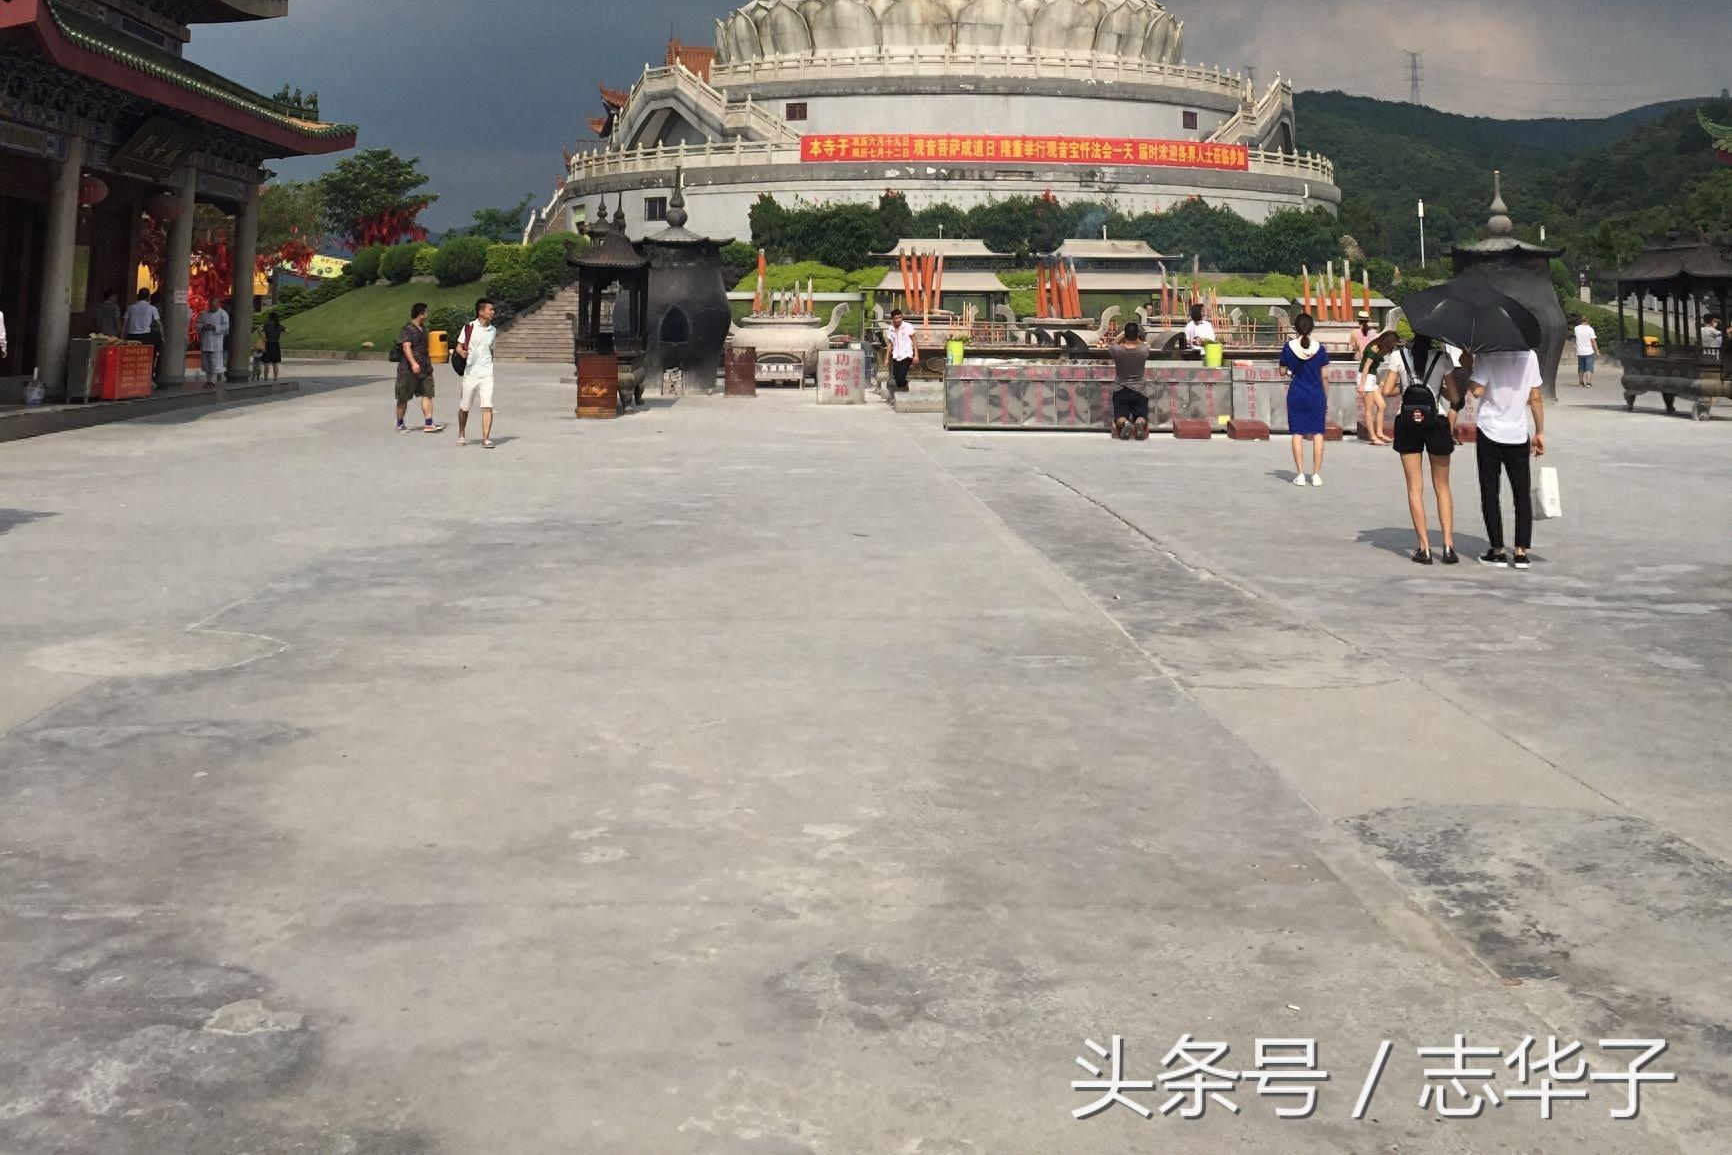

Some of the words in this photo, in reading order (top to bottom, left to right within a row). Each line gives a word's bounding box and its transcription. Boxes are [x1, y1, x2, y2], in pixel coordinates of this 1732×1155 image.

[809, 137, 850, 158] 本寺于
[913, 137, 995, 158] 观音菩萨成道日
